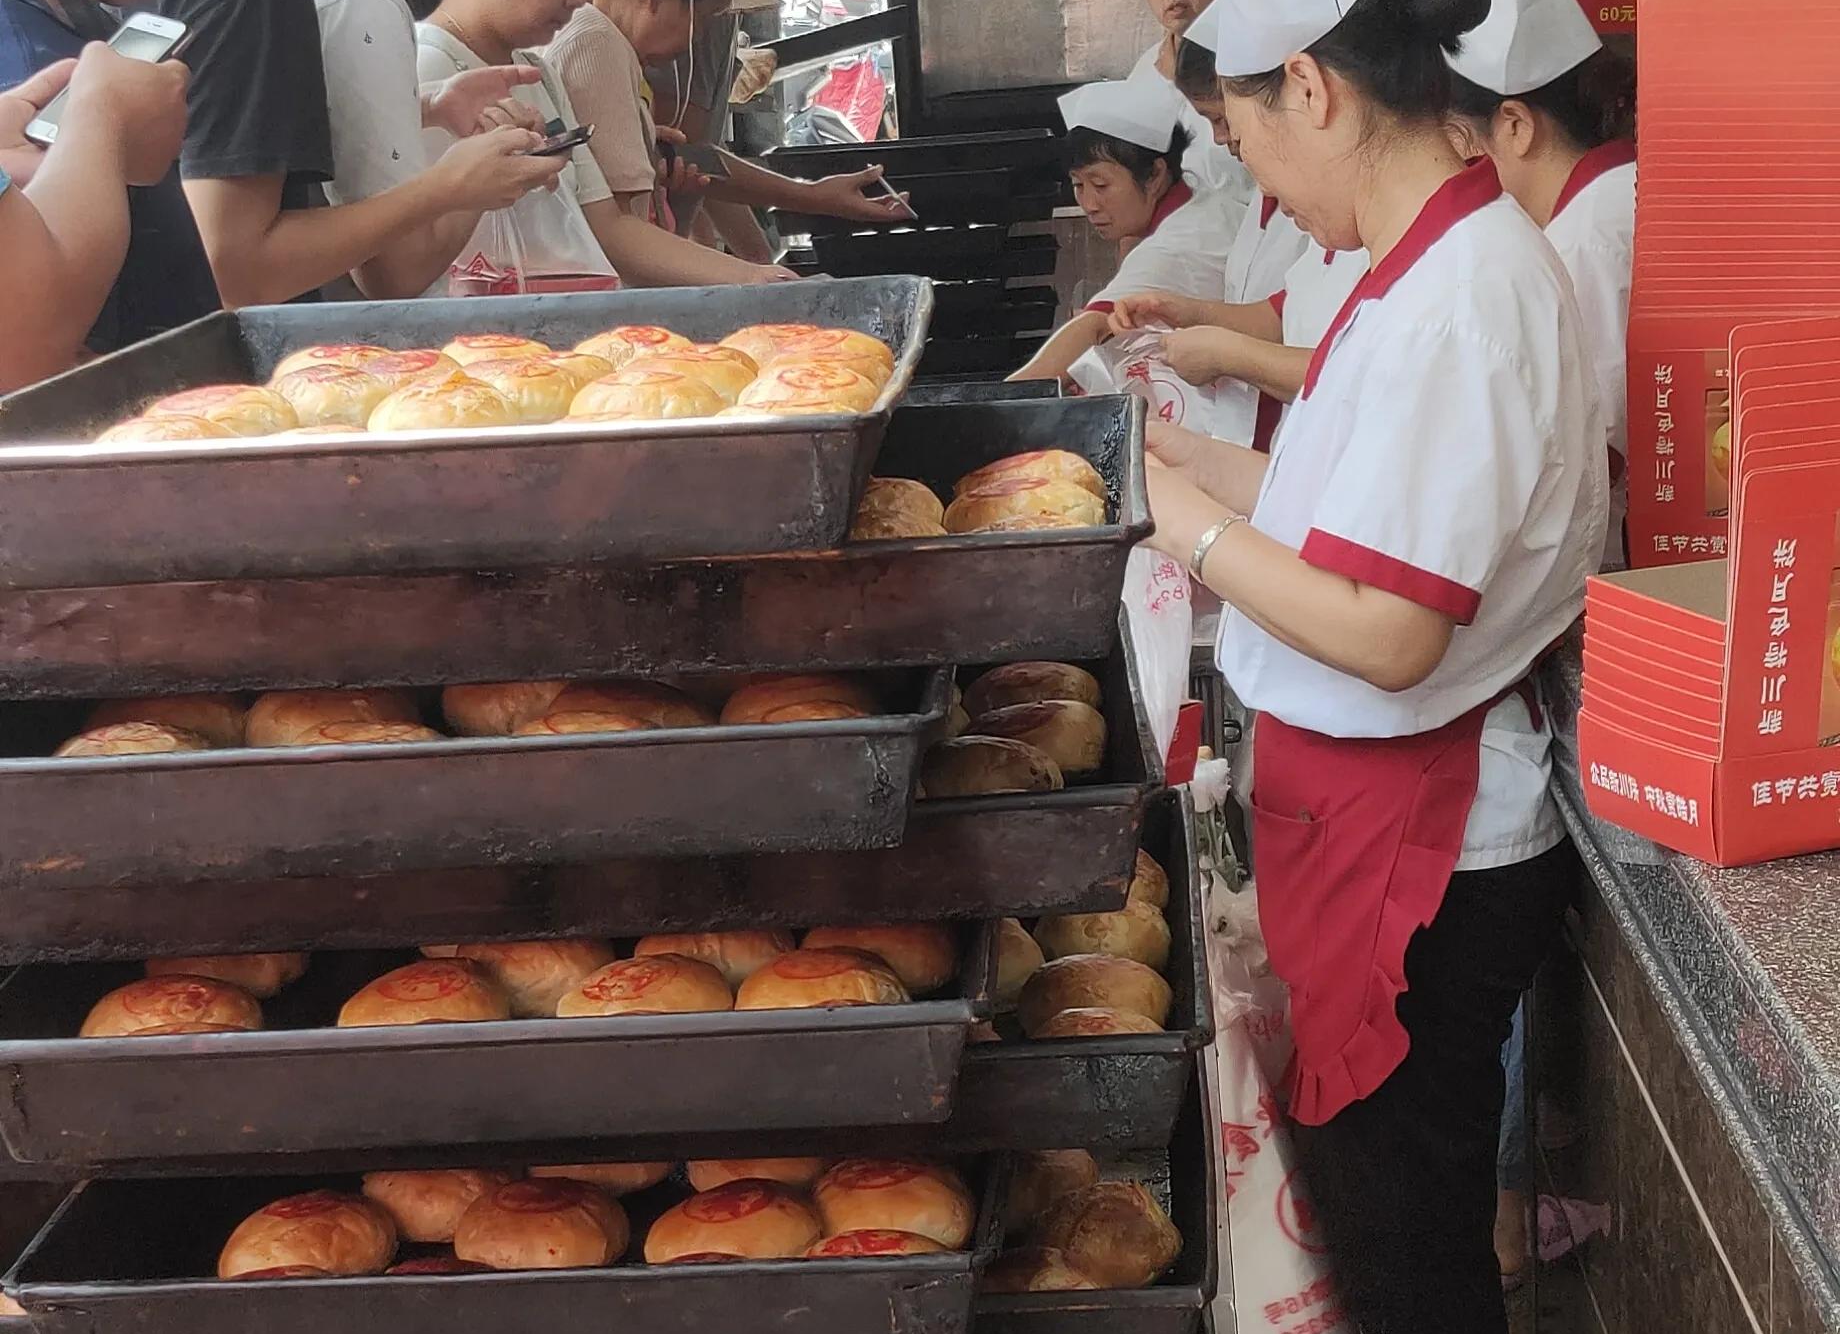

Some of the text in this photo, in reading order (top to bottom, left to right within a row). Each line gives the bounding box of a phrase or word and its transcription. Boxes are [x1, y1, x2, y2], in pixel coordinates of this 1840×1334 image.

[1601, 6, 1635, 22] 60元
[1654, 363, 1675, 502] 新川特色月饼
[1758, 538, 1798, 735] 新川特色月饼
